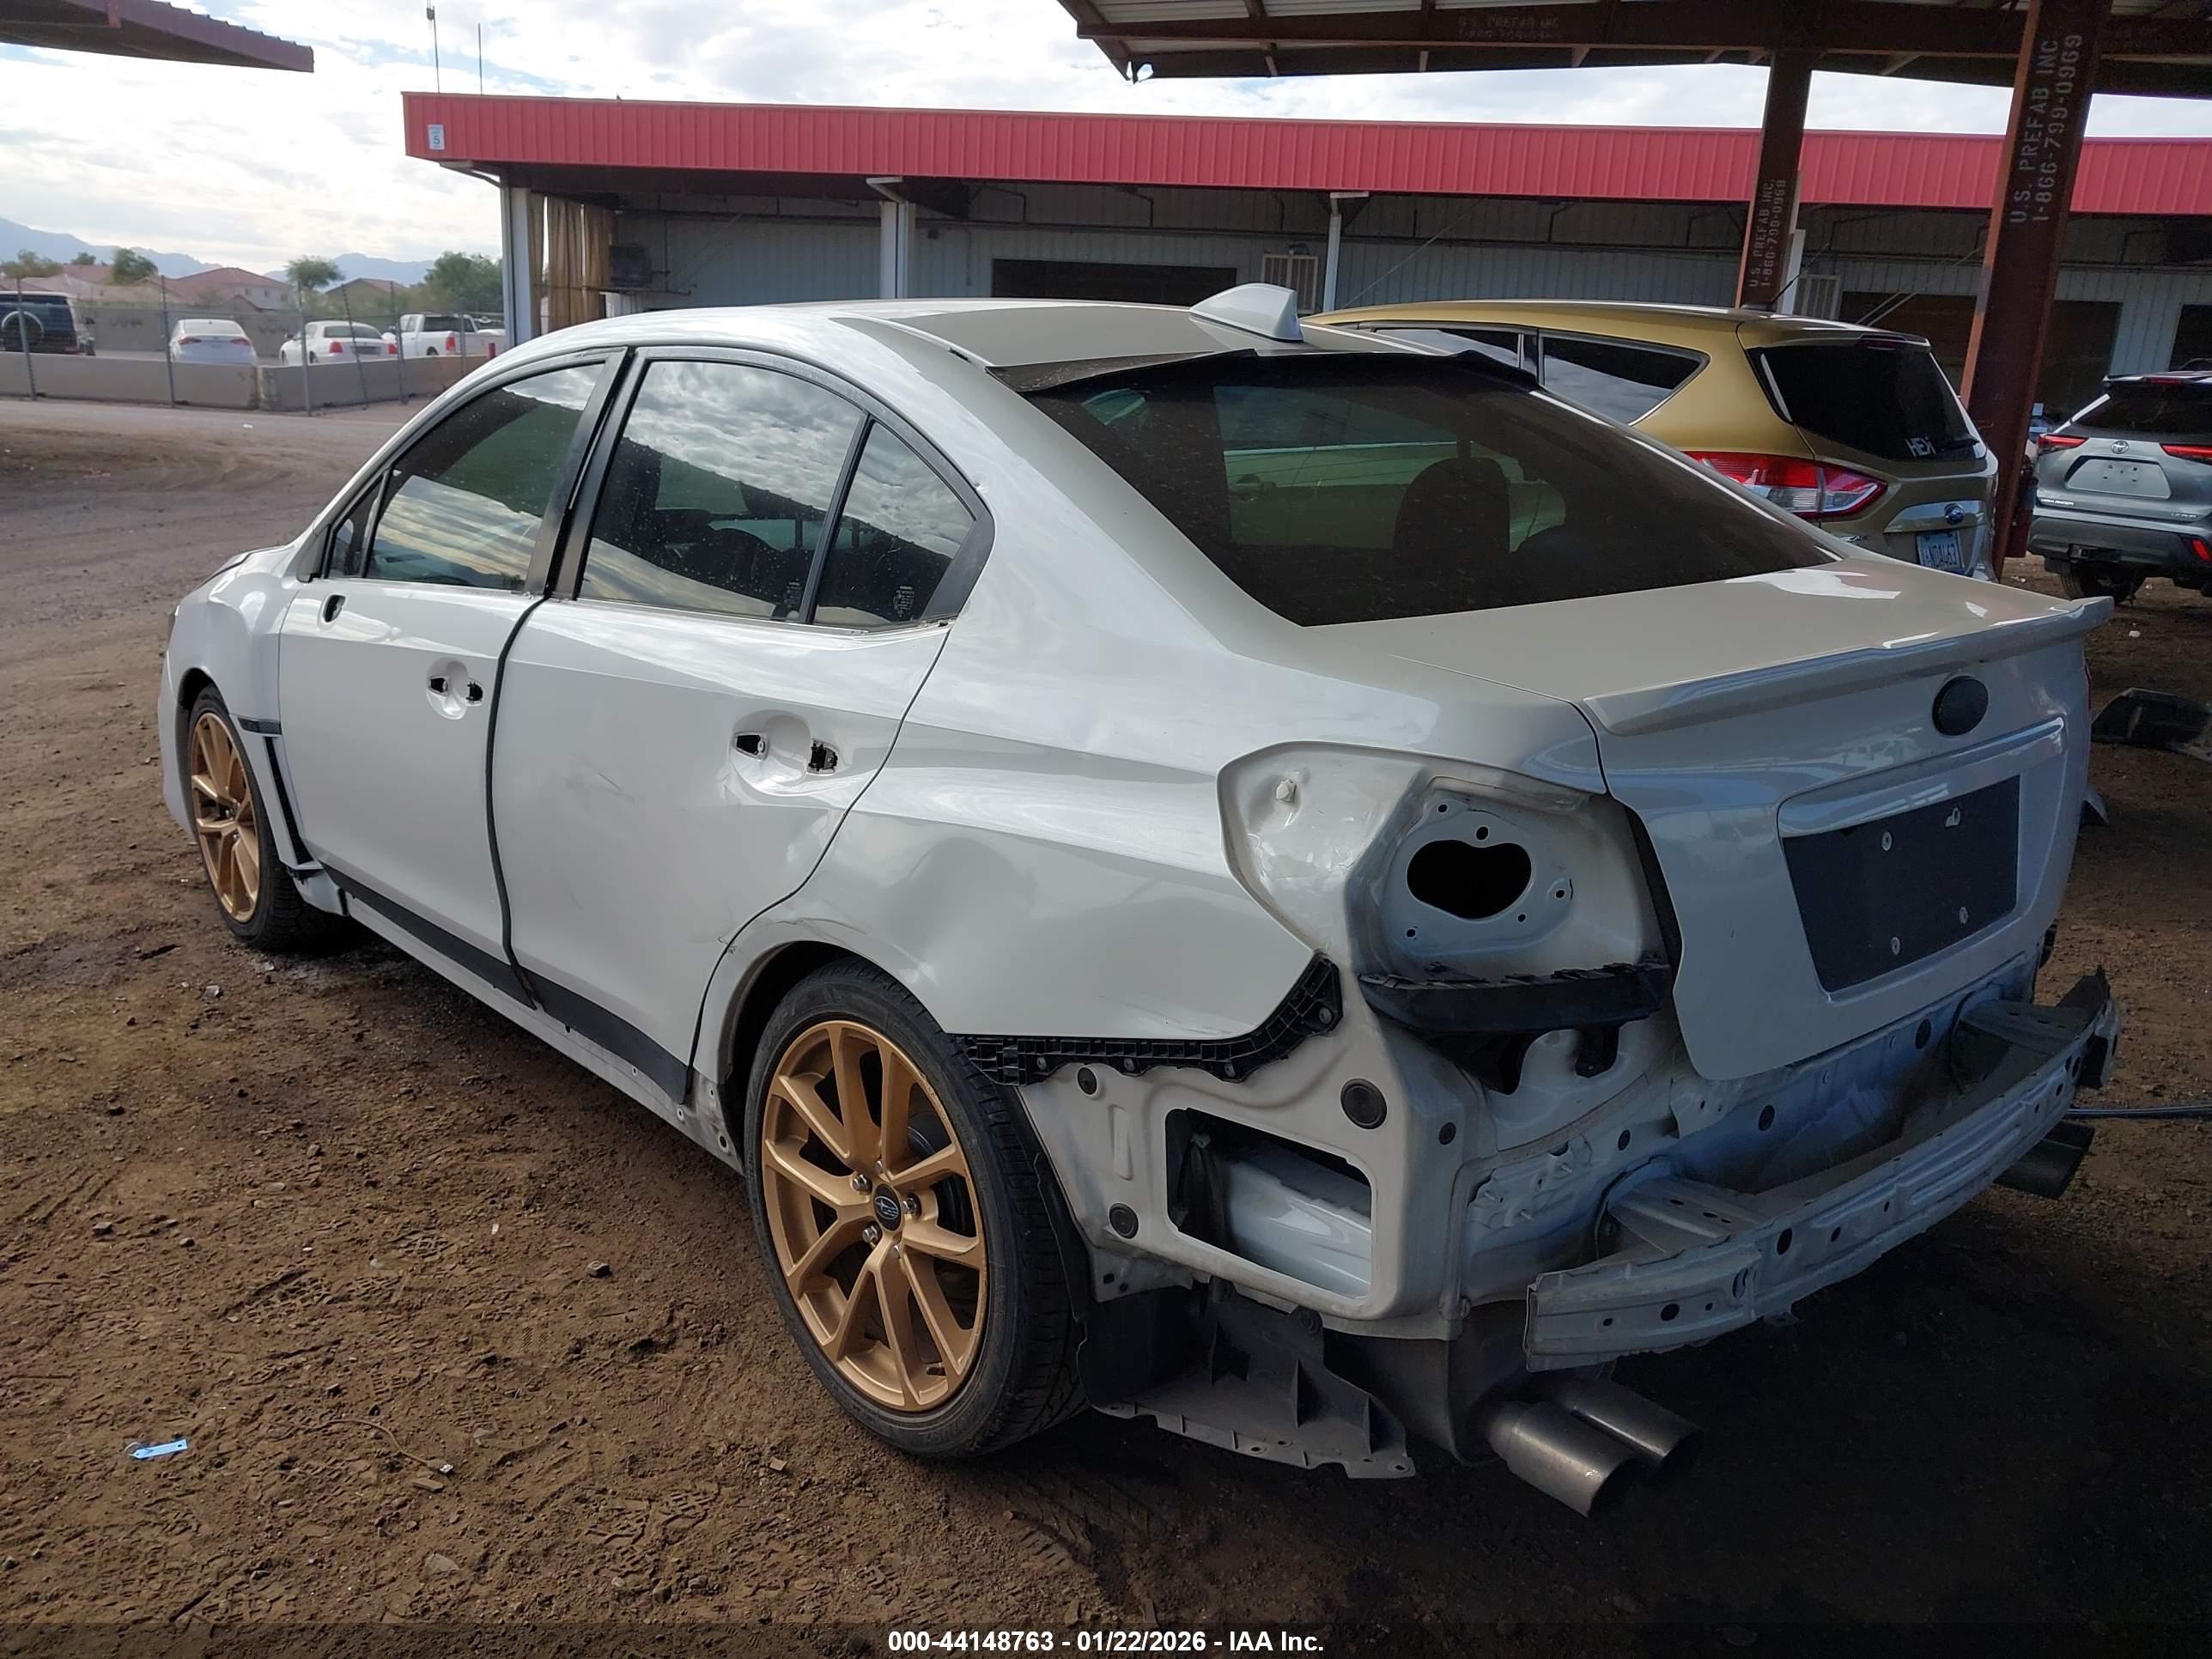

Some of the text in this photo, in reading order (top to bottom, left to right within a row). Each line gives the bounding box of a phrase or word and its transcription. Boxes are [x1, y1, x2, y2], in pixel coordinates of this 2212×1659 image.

[2009, 40, 2059, 223] U.S. PREFAB INC
[2032, 34, 2082, 222] 1-866-799-0969
[1748, 263, 1762, 287] U.S.
[1753, 209, 1771, 258] PREFAB
